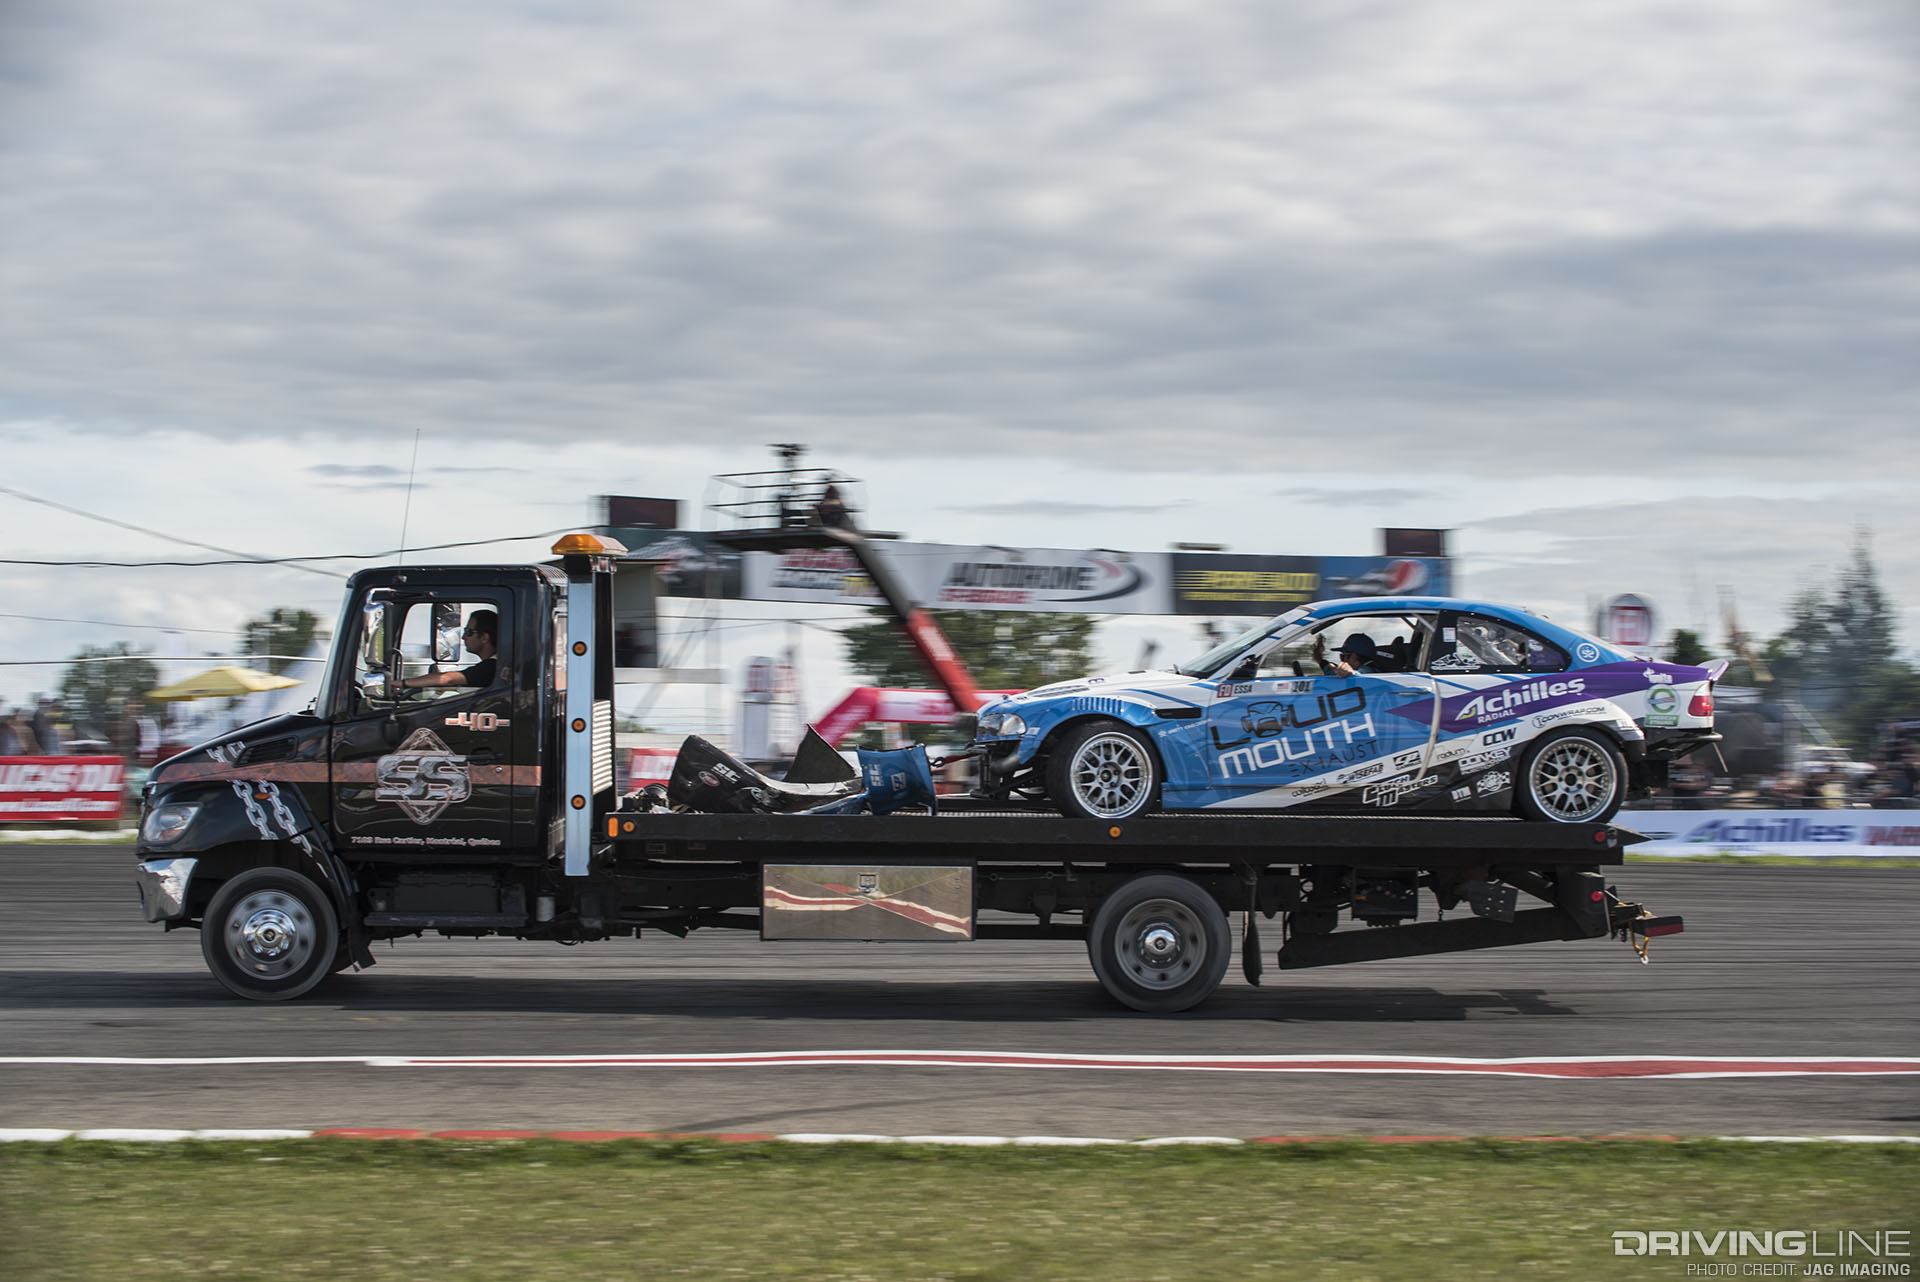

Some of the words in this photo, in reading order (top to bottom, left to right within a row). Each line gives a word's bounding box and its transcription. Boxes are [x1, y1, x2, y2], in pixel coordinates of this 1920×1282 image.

[1234, 685, 1253, 694] ESSA
[1455, 678, 1586, 721] Achilles
[1478, 709, 1515, 724] RADIAL
[1218, 712, 1376, 778] MOUTH
[1483, 728, 1517, 746] CCW
[1458, 747, 1511, 769] DONKEY
[1682, 818, 1858, 843] Achilles
